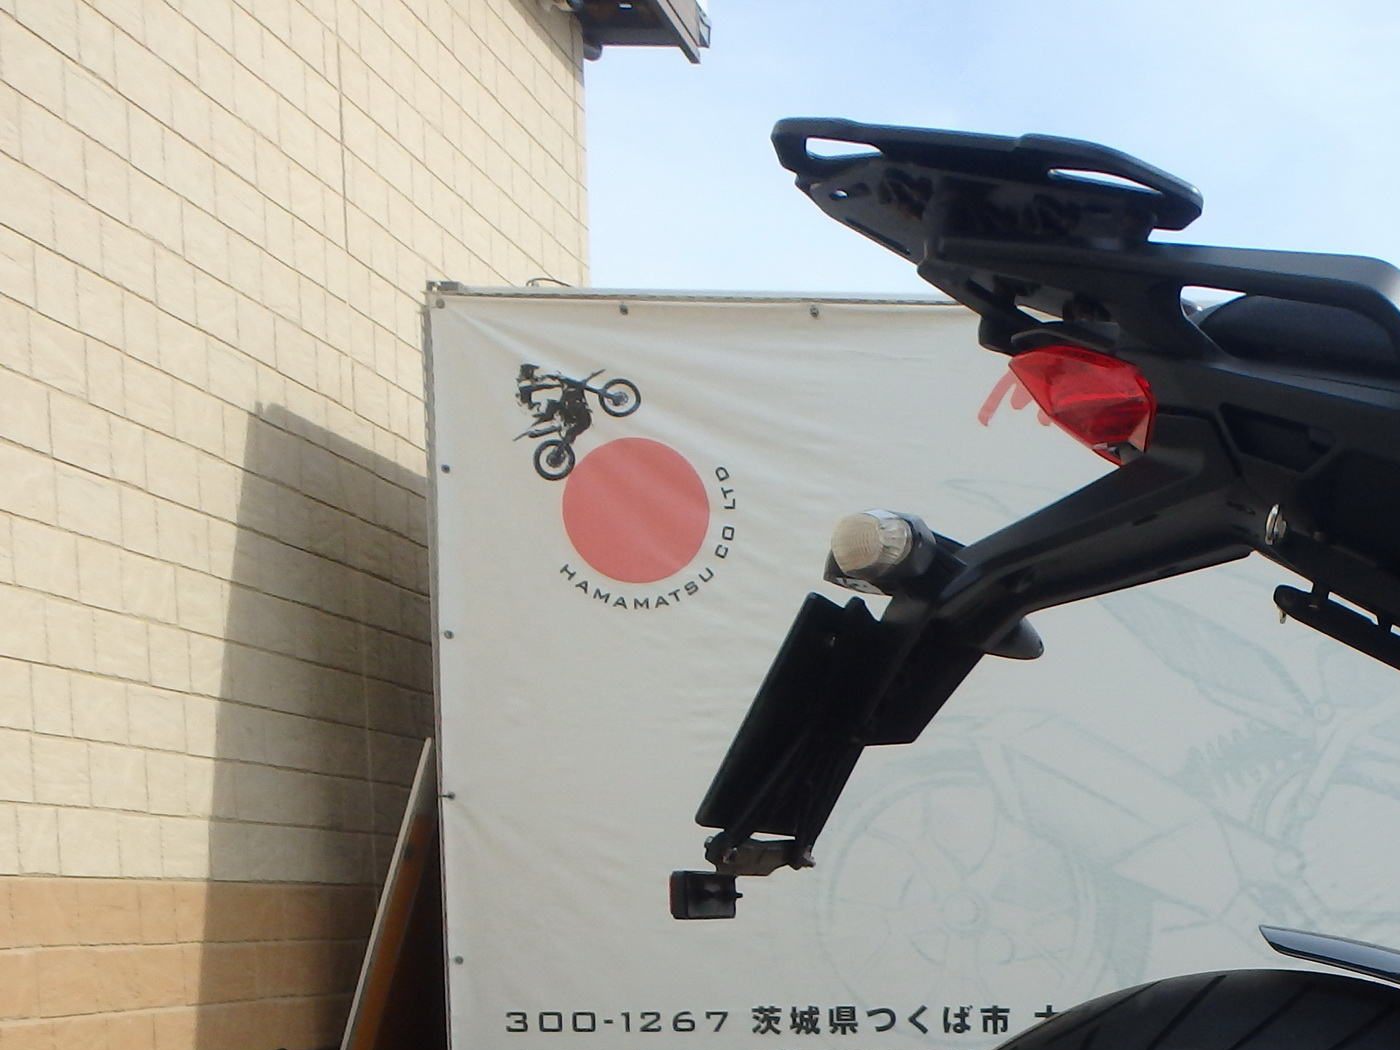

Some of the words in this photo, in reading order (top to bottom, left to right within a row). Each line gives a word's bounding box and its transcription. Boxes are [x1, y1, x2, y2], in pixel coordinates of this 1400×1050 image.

[715, 466, 736, 510] LTD
[714, 526, 735, 559] CO
[560, 563, 714, 610] HAMAMATSU
[505, 1010, 728, 1033] 300-1267
[751, 1004, 1011, 1036] 茨城県つくば市
